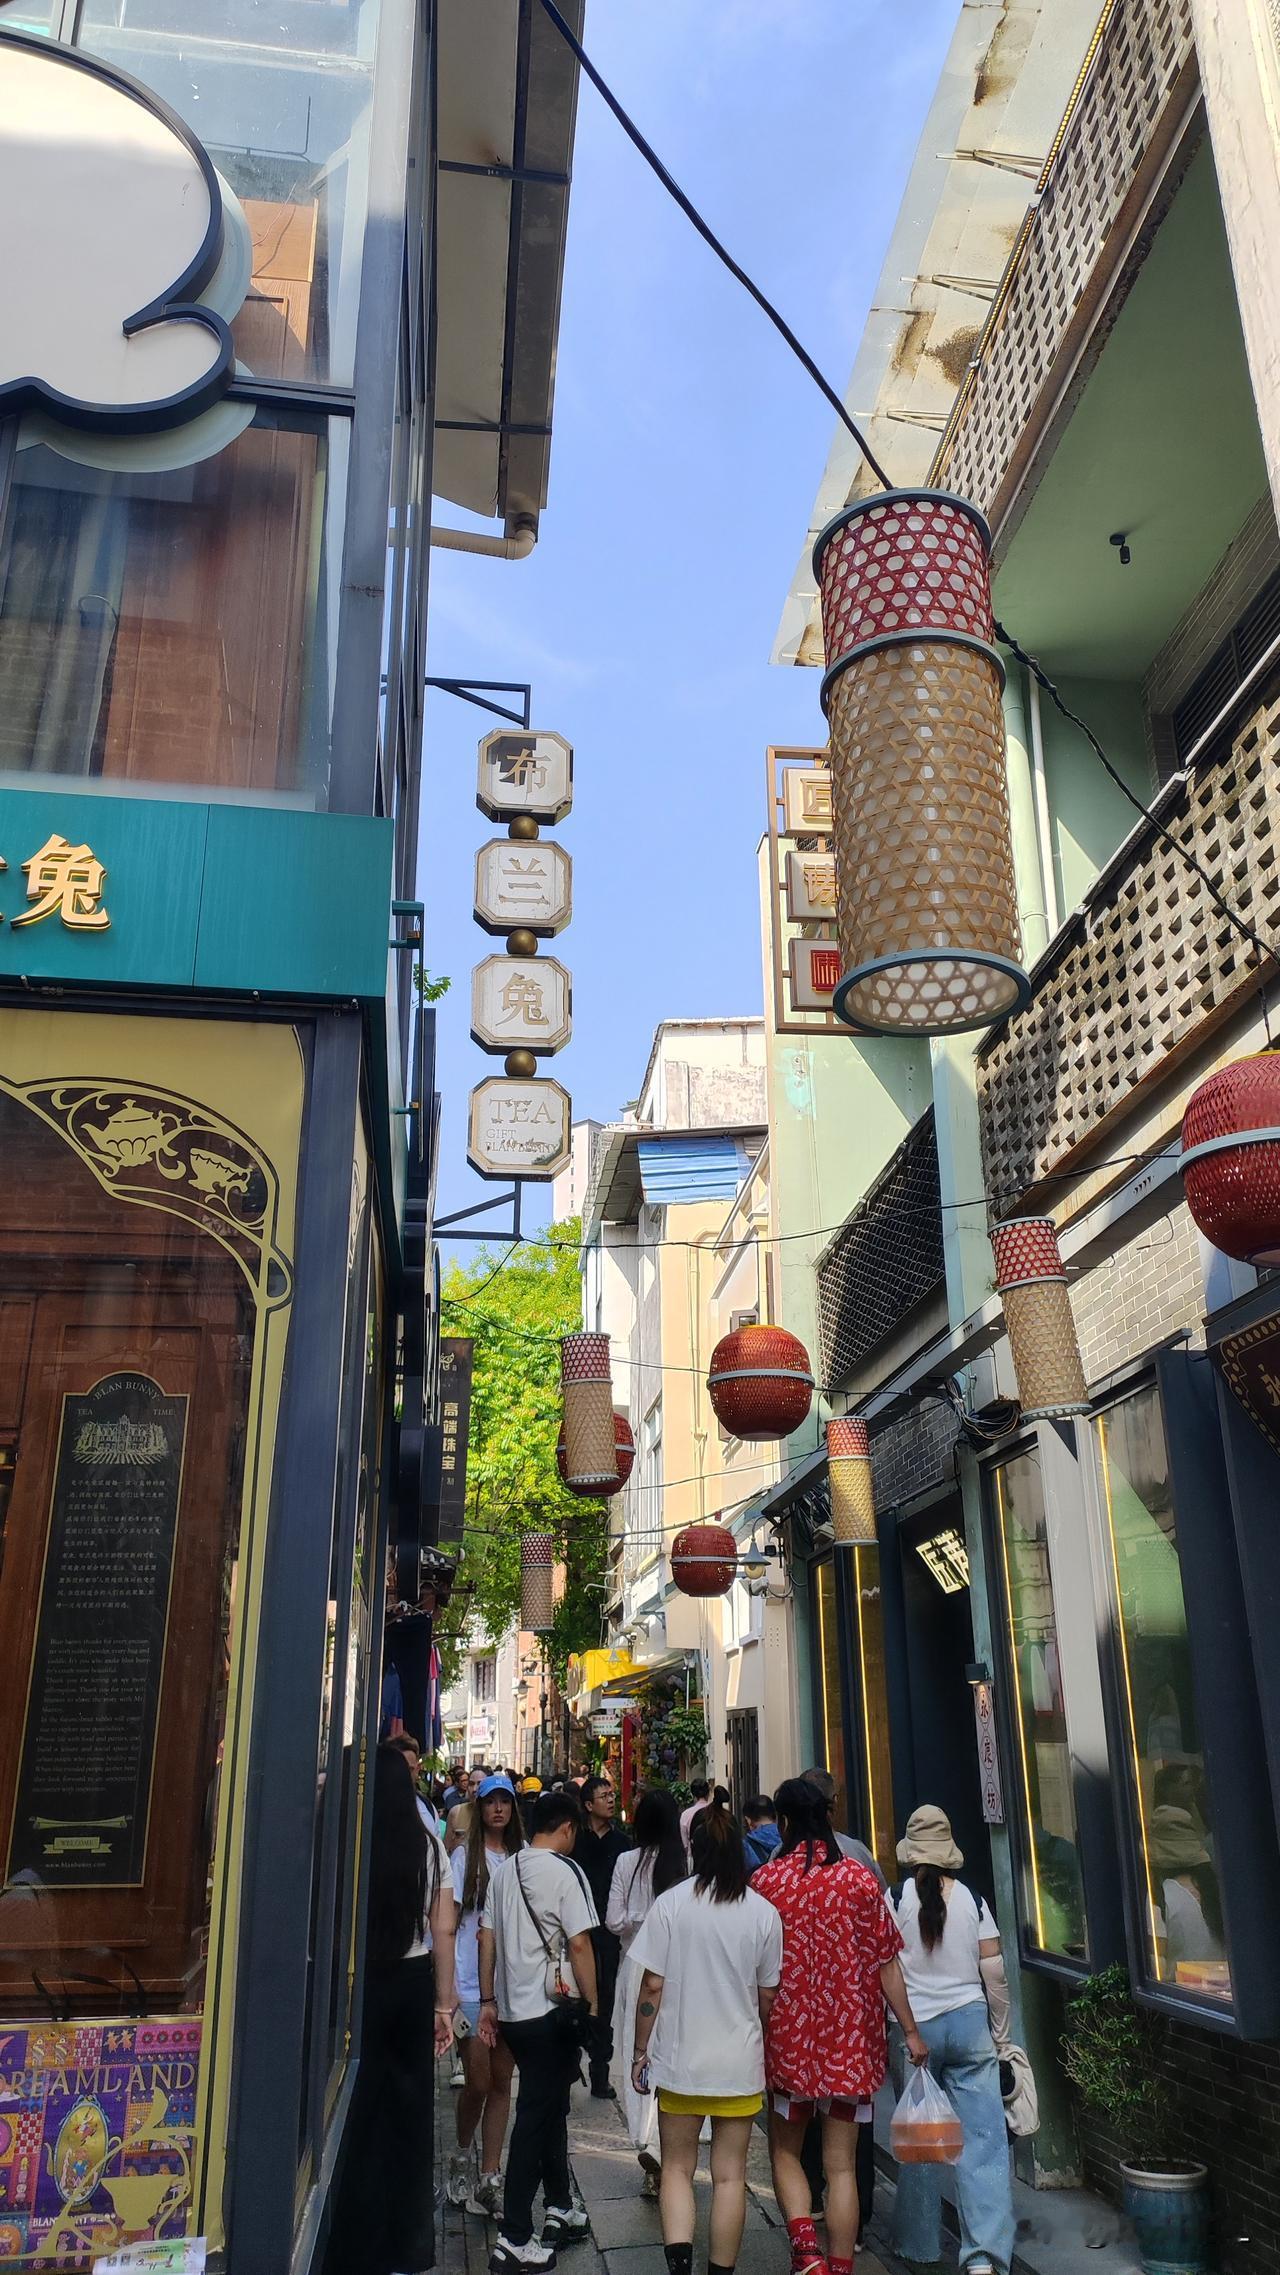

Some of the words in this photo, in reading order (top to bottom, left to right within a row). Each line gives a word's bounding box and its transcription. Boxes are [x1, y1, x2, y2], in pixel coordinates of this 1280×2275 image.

[0, 833, 112, 931] 兔
[495, 747, 551, 1026] 布兰兔
[489, 1097, 557, 1124] TEA
[486, 1129, 517, 1139] GIFT
[94, 1381, 122, 1400] BLAN
[125, 1381, 160, 1400] BUNNY
[78, 1408, 93, 1416] TEA
[153, 1408, 175, 1416] TIME
[441, 1402, 459, 1470] 高端珠宝
